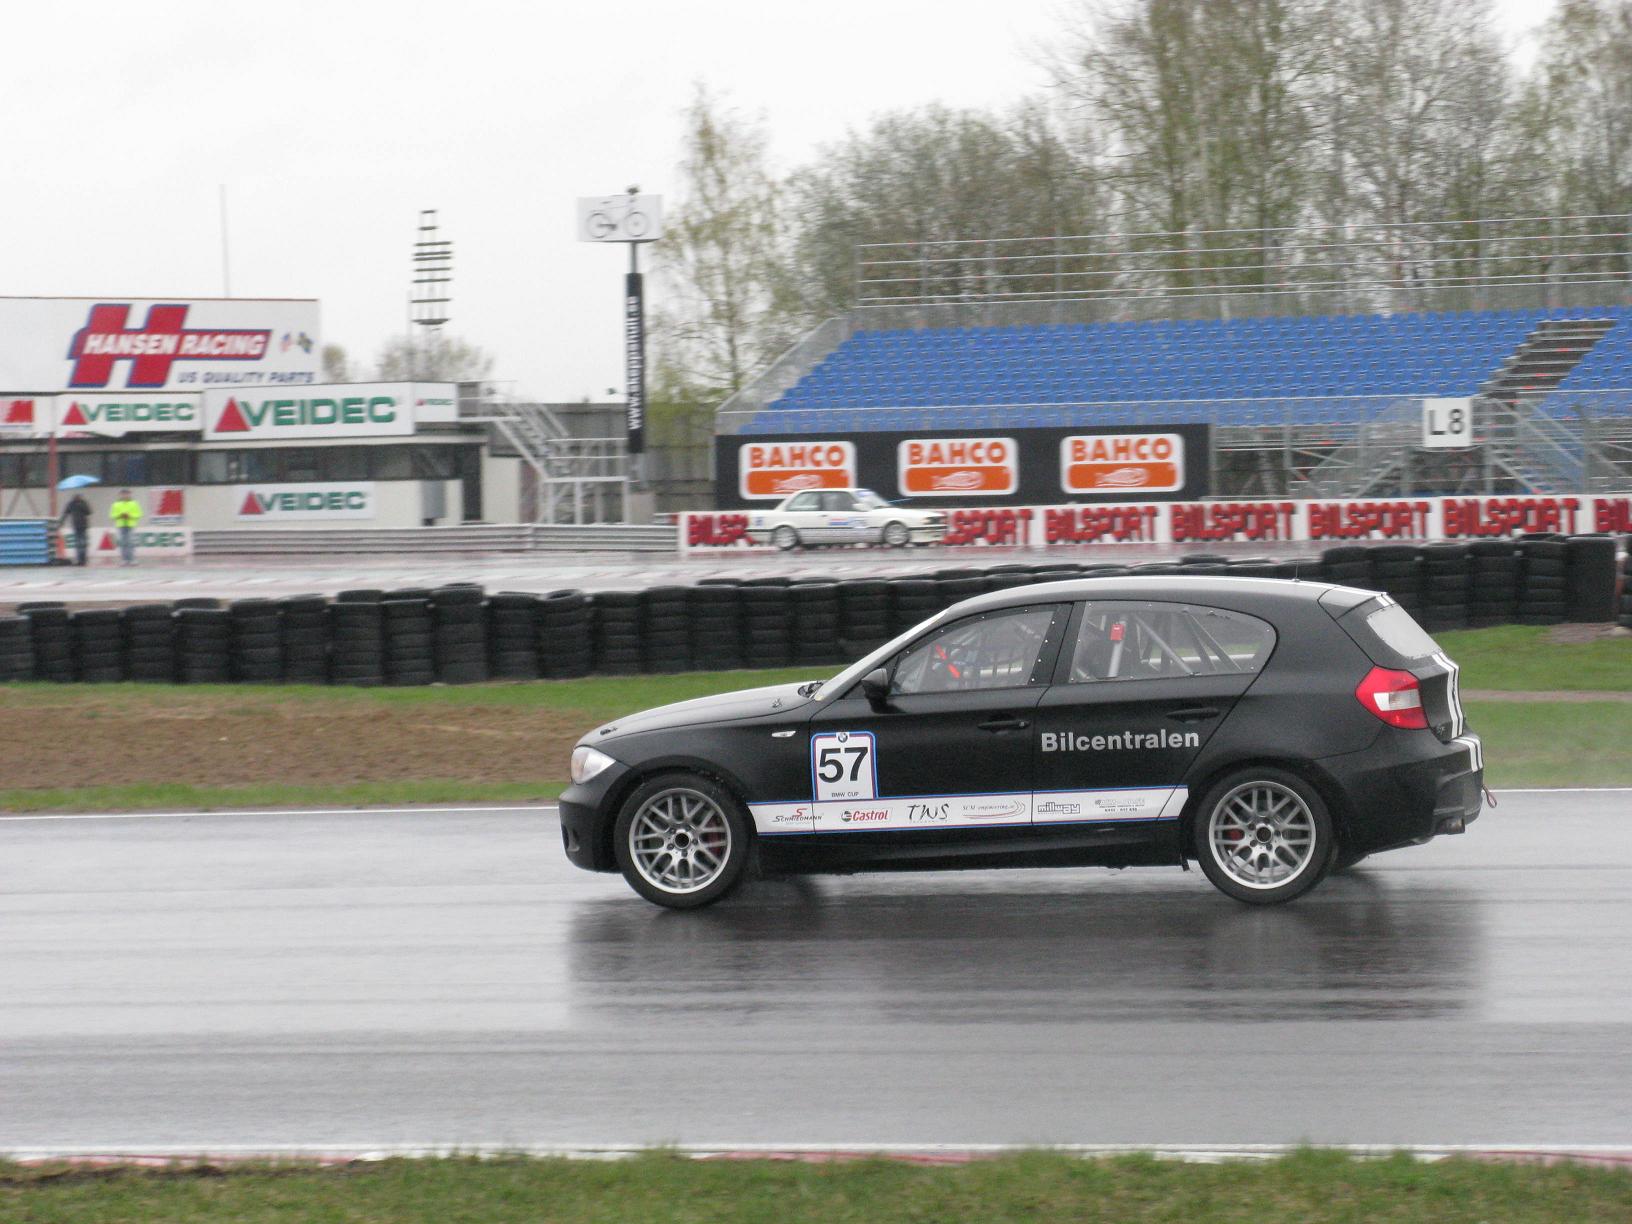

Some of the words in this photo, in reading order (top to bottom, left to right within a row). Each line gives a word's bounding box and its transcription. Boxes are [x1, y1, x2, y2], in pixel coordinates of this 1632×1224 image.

[82, 333, 179, 354] HANSEN
[178, 334, 266, 355] RACING
[177, 371, 196, 383] US
[203, 371, 265, 383] QUALITY
[269, 371, 315, 383] PARTS
[79, 402, 195, 422] VEIDEC
[240, 397, 397, 427] VEIDEC
[1428, 408, 1466, 436] L8
[748, 445, 846, 468] BAHCO
[907, 441, 1008, 465] BAHCO
[1070, 437, 1174, 462] BAHCO
[256, 491, 367, 511] VEIDEC
[1045, 505, 1159, 544] BILSPORT
[1170, 503, 1295, 542] BILSPORT
[1307, 501, 1430, 539] BILSPORT
[1443, 498, 1581, 537] BILSPORT
[1041, 728, 1199, 752] Bilcentralen
[818, 746, 869, 783] 57
[853, 810, 889, 822] Castrol
[907, 803, 950, 820] TWS
[1037, 801, 1081, 814] millway
